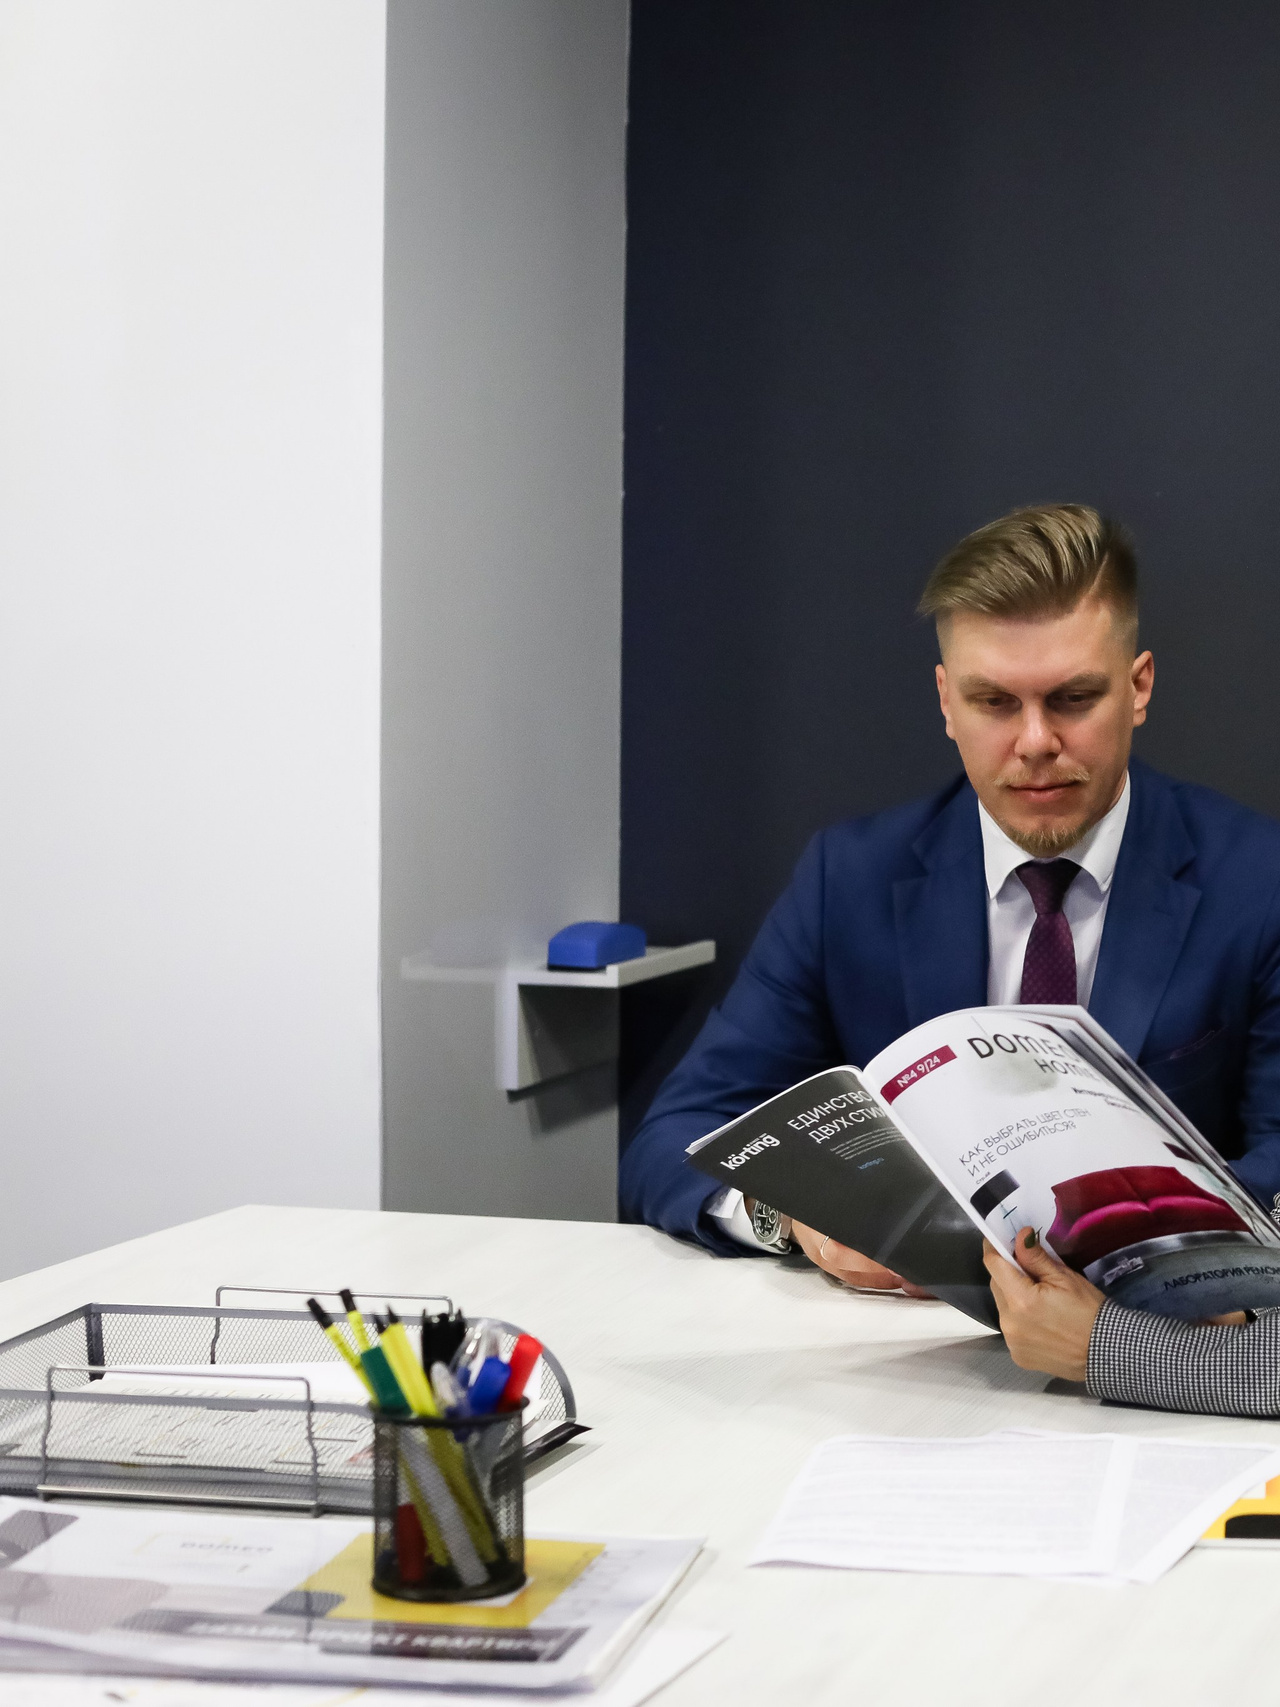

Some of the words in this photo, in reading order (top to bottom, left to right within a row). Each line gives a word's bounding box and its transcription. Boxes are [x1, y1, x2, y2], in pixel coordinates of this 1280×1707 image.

[917, 1055, 941, 1075] 9/24
[787, 1090, 873, 1131] ЕДИНСТВО
[808, 1116, 854, 1144] ДВУХ
[959, 1143, 985, 1166] КАК
[983, 1119, 1038, 1148] ВЫБРАТЬ
[1035, 1110, 1063, 1125] ЦВЕТ
[1063, 1107, 1092, 1119] СТЕН
[720, 1134, 781, 1170] körting
[967, 1164, 980, 1178] И
[979, 1152, 998, 1170] НЕ
[996, 1120, 1078, 1157] ОШИБИТЬСЯ?
[1163, 1268, 1245, 1291] ЛАБОРАТОРИЯ
